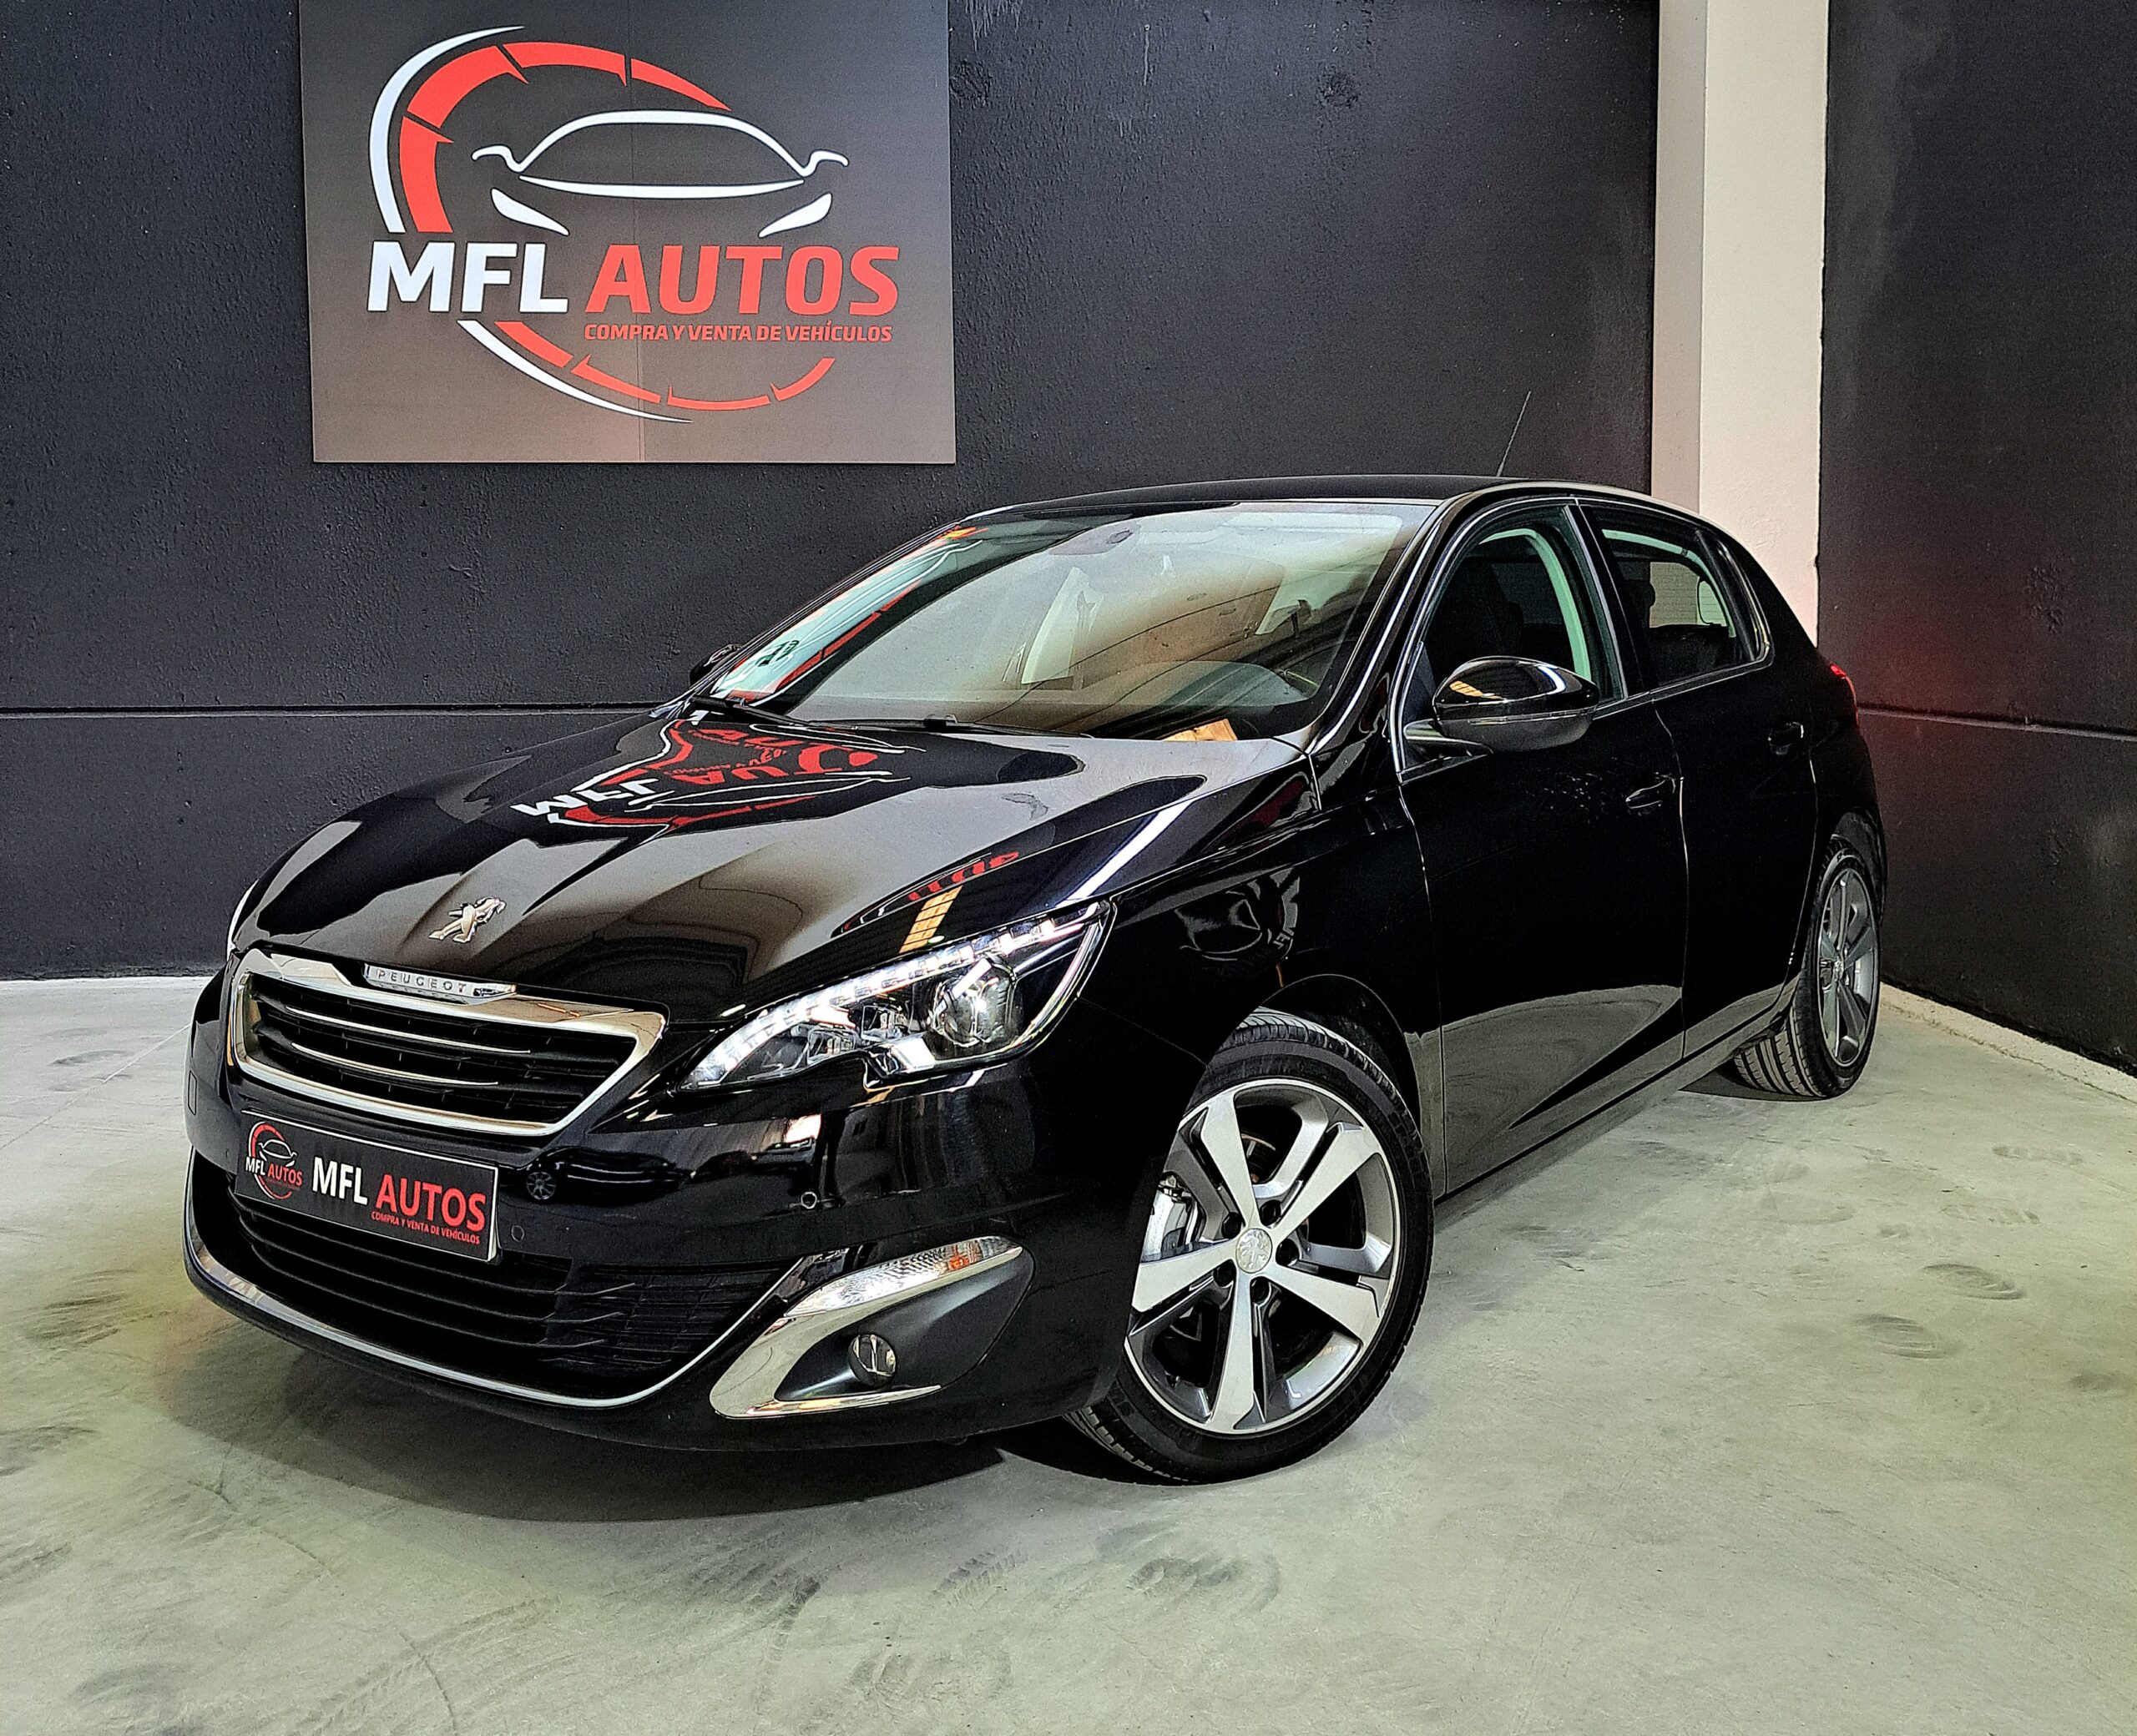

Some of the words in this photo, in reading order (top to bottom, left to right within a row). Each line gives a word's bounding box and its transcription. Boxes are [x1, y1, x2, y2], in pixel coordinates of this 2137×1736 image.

[367, 241, 568, 313] MFL
[585, 245, 900, 315] AUTOS
[584, 323, 668, 341] COMPRA
[670, 325, 683, 341] Y
[689, 325, 752, 342] VENTA
[756, 326, 781, 342] DE
[786, 320, 892, 343] VEHÍCULOS
[376, 968, 467, 993] PEUGEOT
[245, 1156, 265, 1176] MFL
[267, 1163, 303, 1187] AUTOS
[312, 1156, 368, 1205] MFL
[375, 1173, 486, 1232] AUTOS
[371, 1211, 399, 1226] COMPRA
[407, 1219, 429, 1233] VENTA
[430, 1225, 440, 1235] DE
